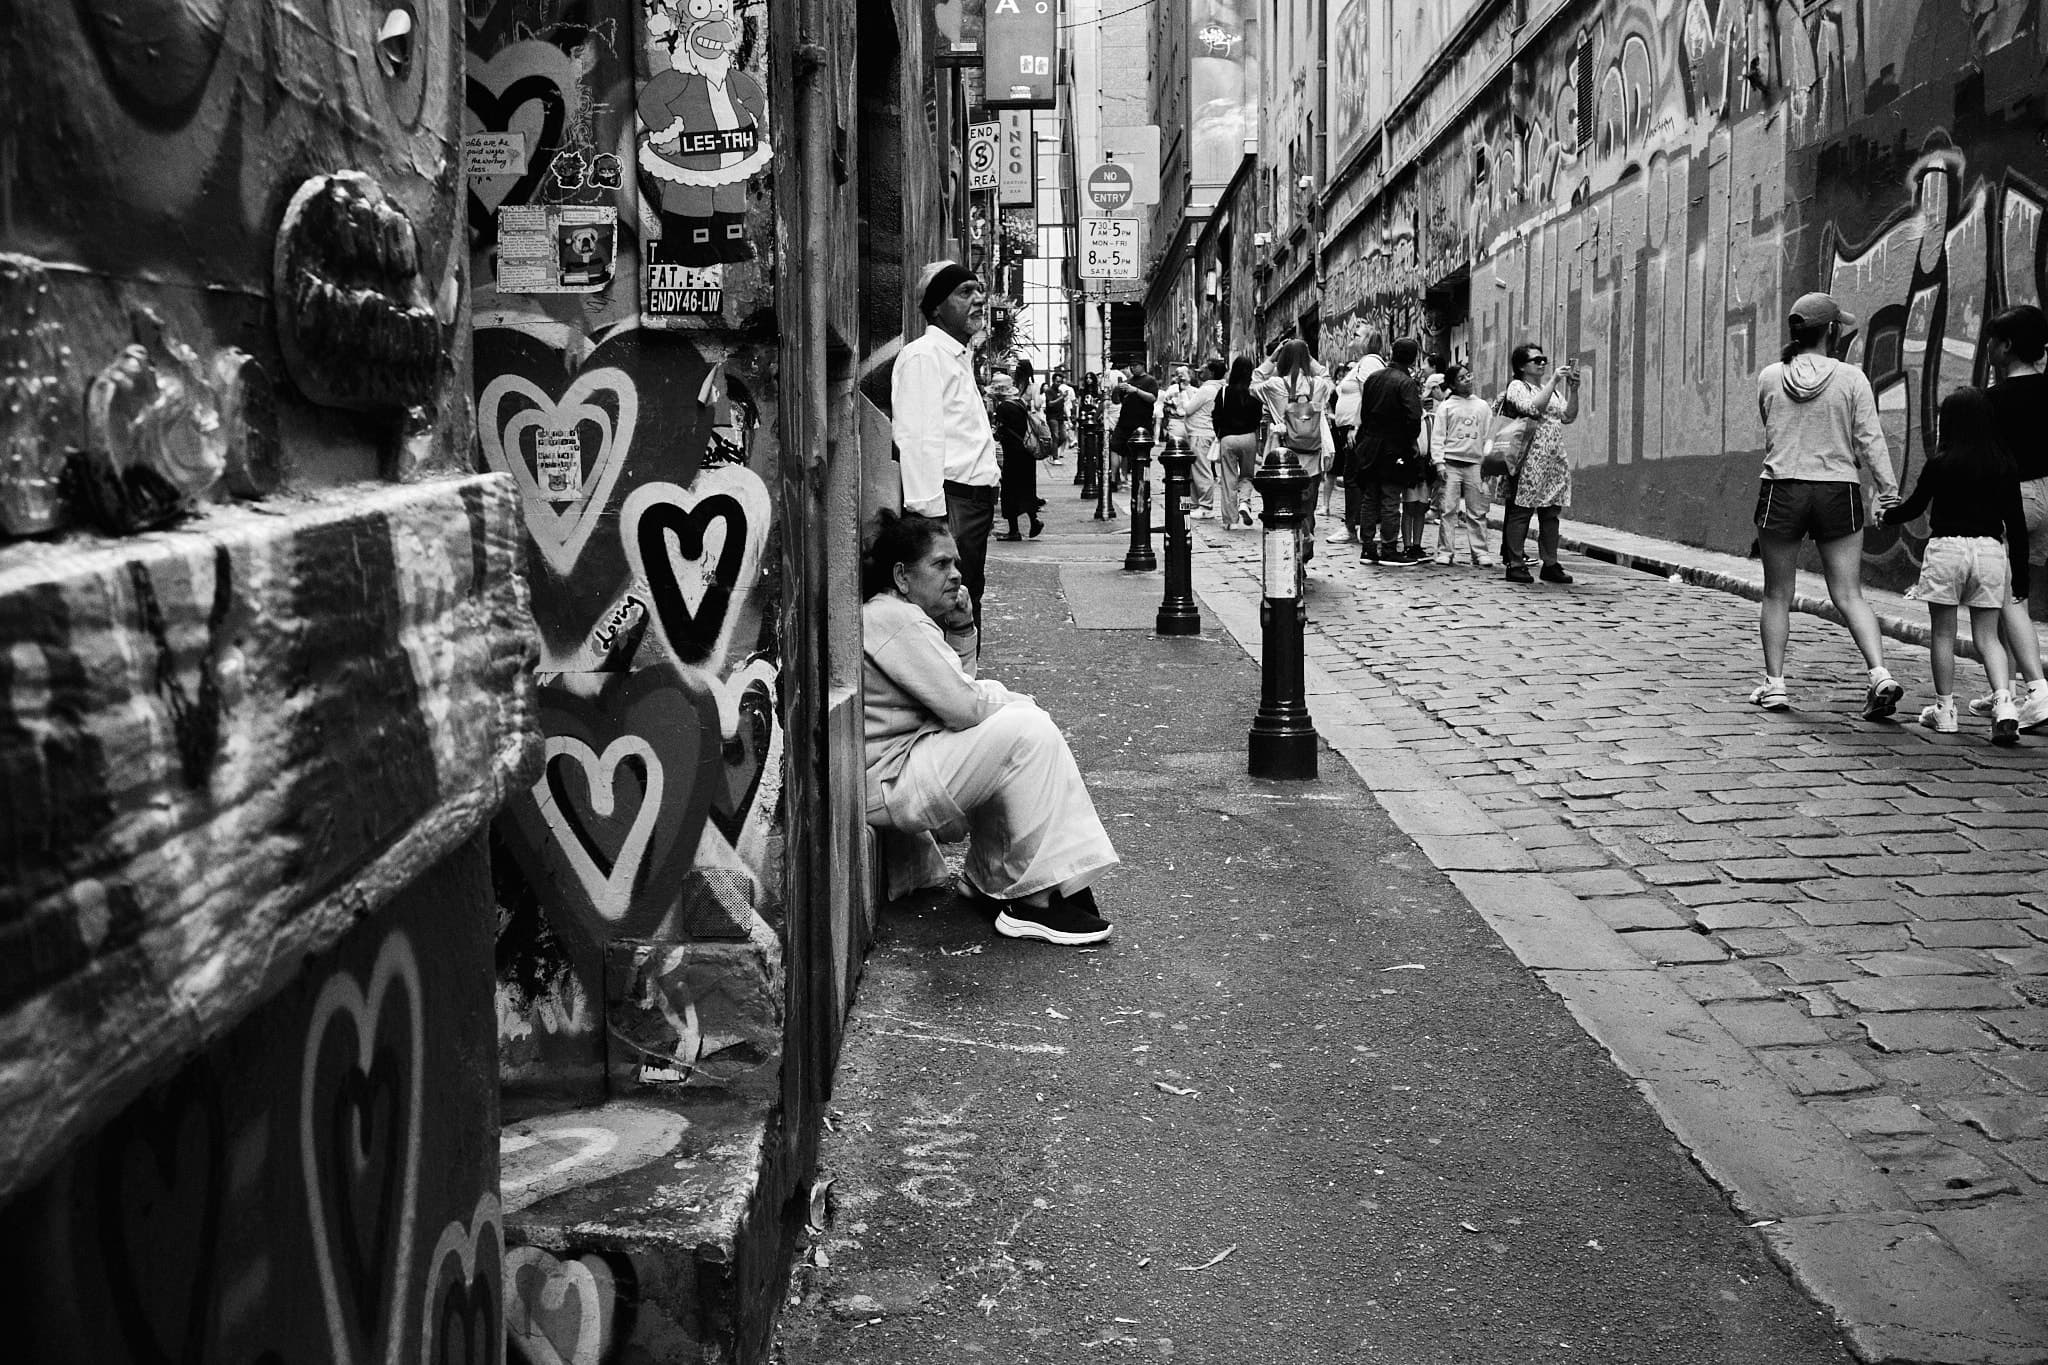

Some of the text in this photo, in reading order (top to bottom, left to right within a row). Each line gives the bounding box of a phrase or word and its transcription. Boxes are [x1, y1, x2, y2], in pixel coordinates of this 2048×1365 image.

[970, 127, 993, 139] END
[1103, 171, 1117, 181] NO
[1093, 193, 1126, 203] ENTRY
